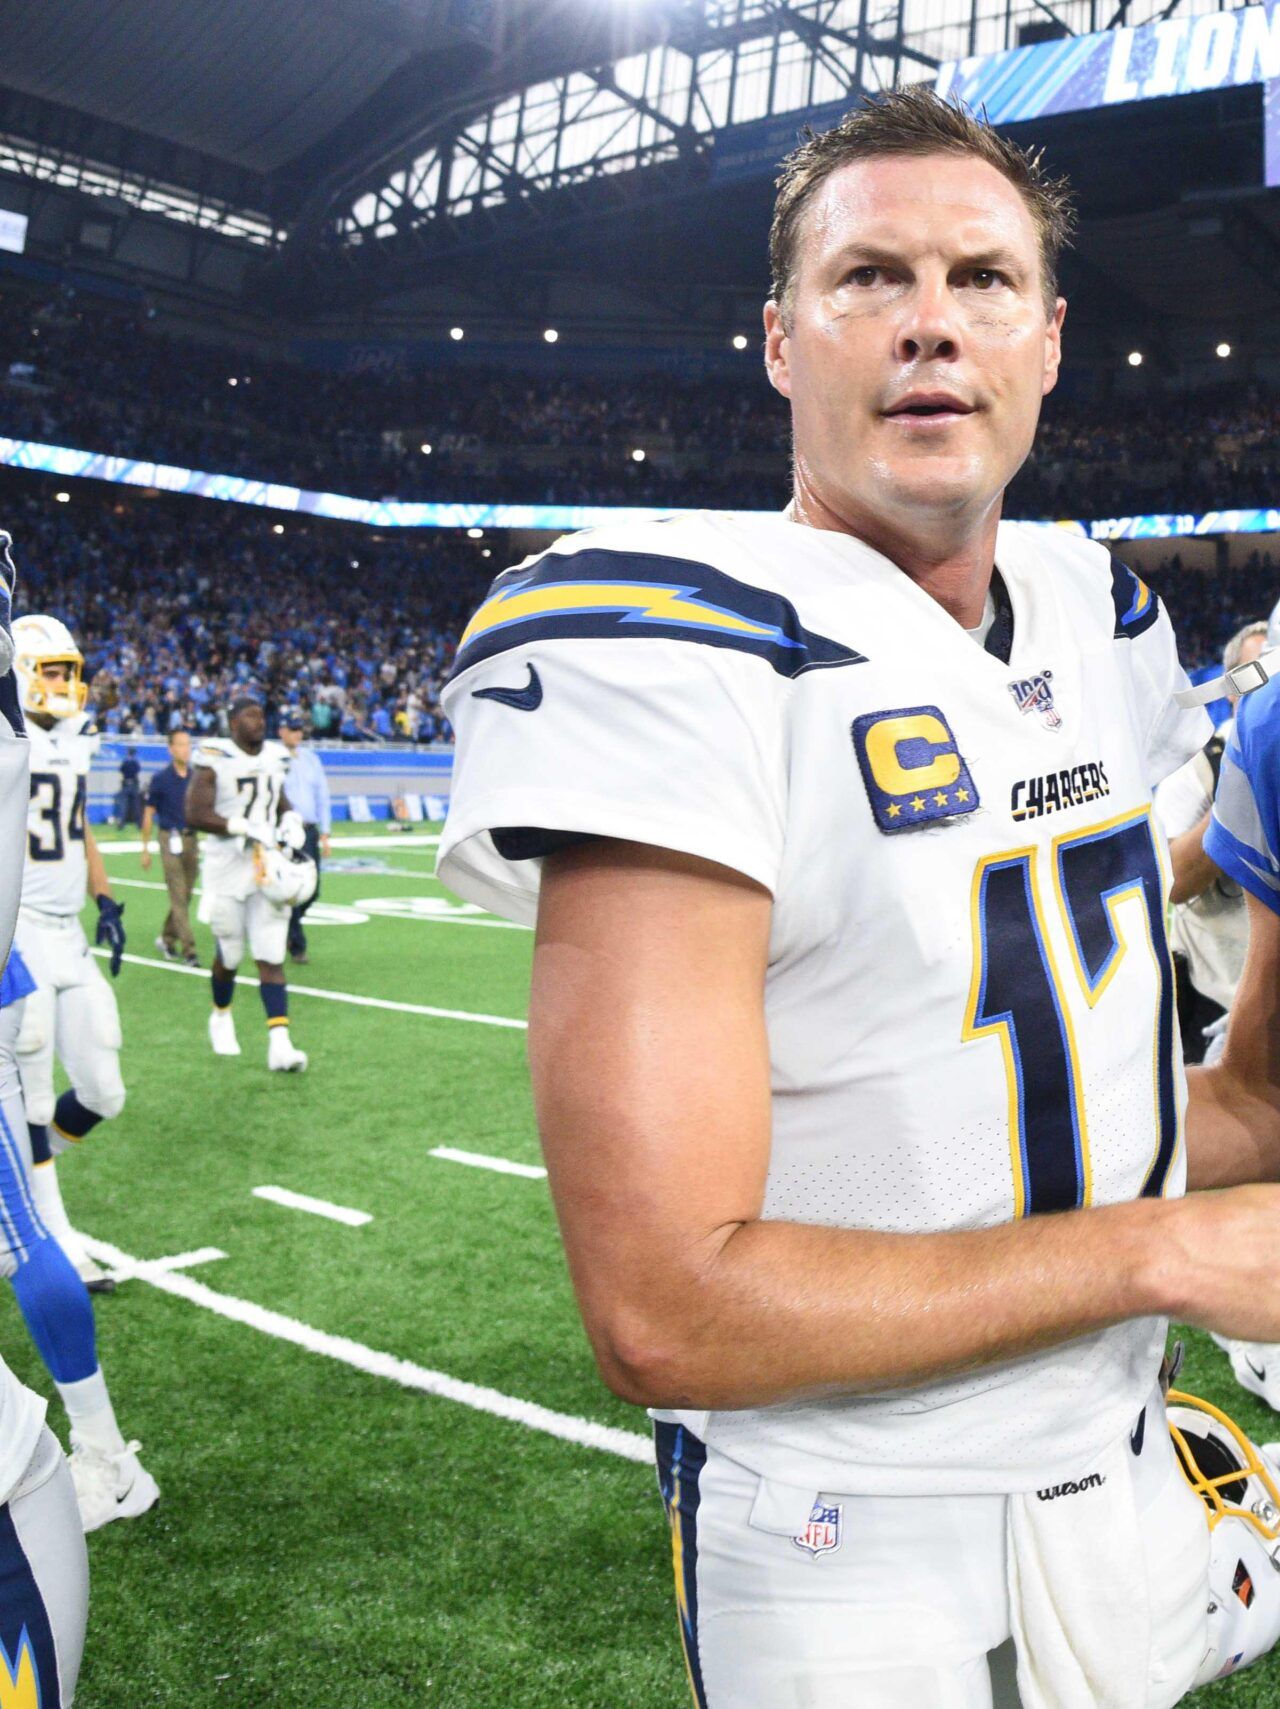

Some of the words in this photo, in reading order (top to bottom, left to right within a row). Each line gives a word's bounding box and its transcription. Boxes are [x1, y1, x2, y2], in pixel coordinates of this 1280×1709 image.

[864, 713, 961, 796] C
[236, 775, 274, 822] 71
[1011, 760, 1110, 823] CHARGERS
[961, 803, 1180, 1220] 17
